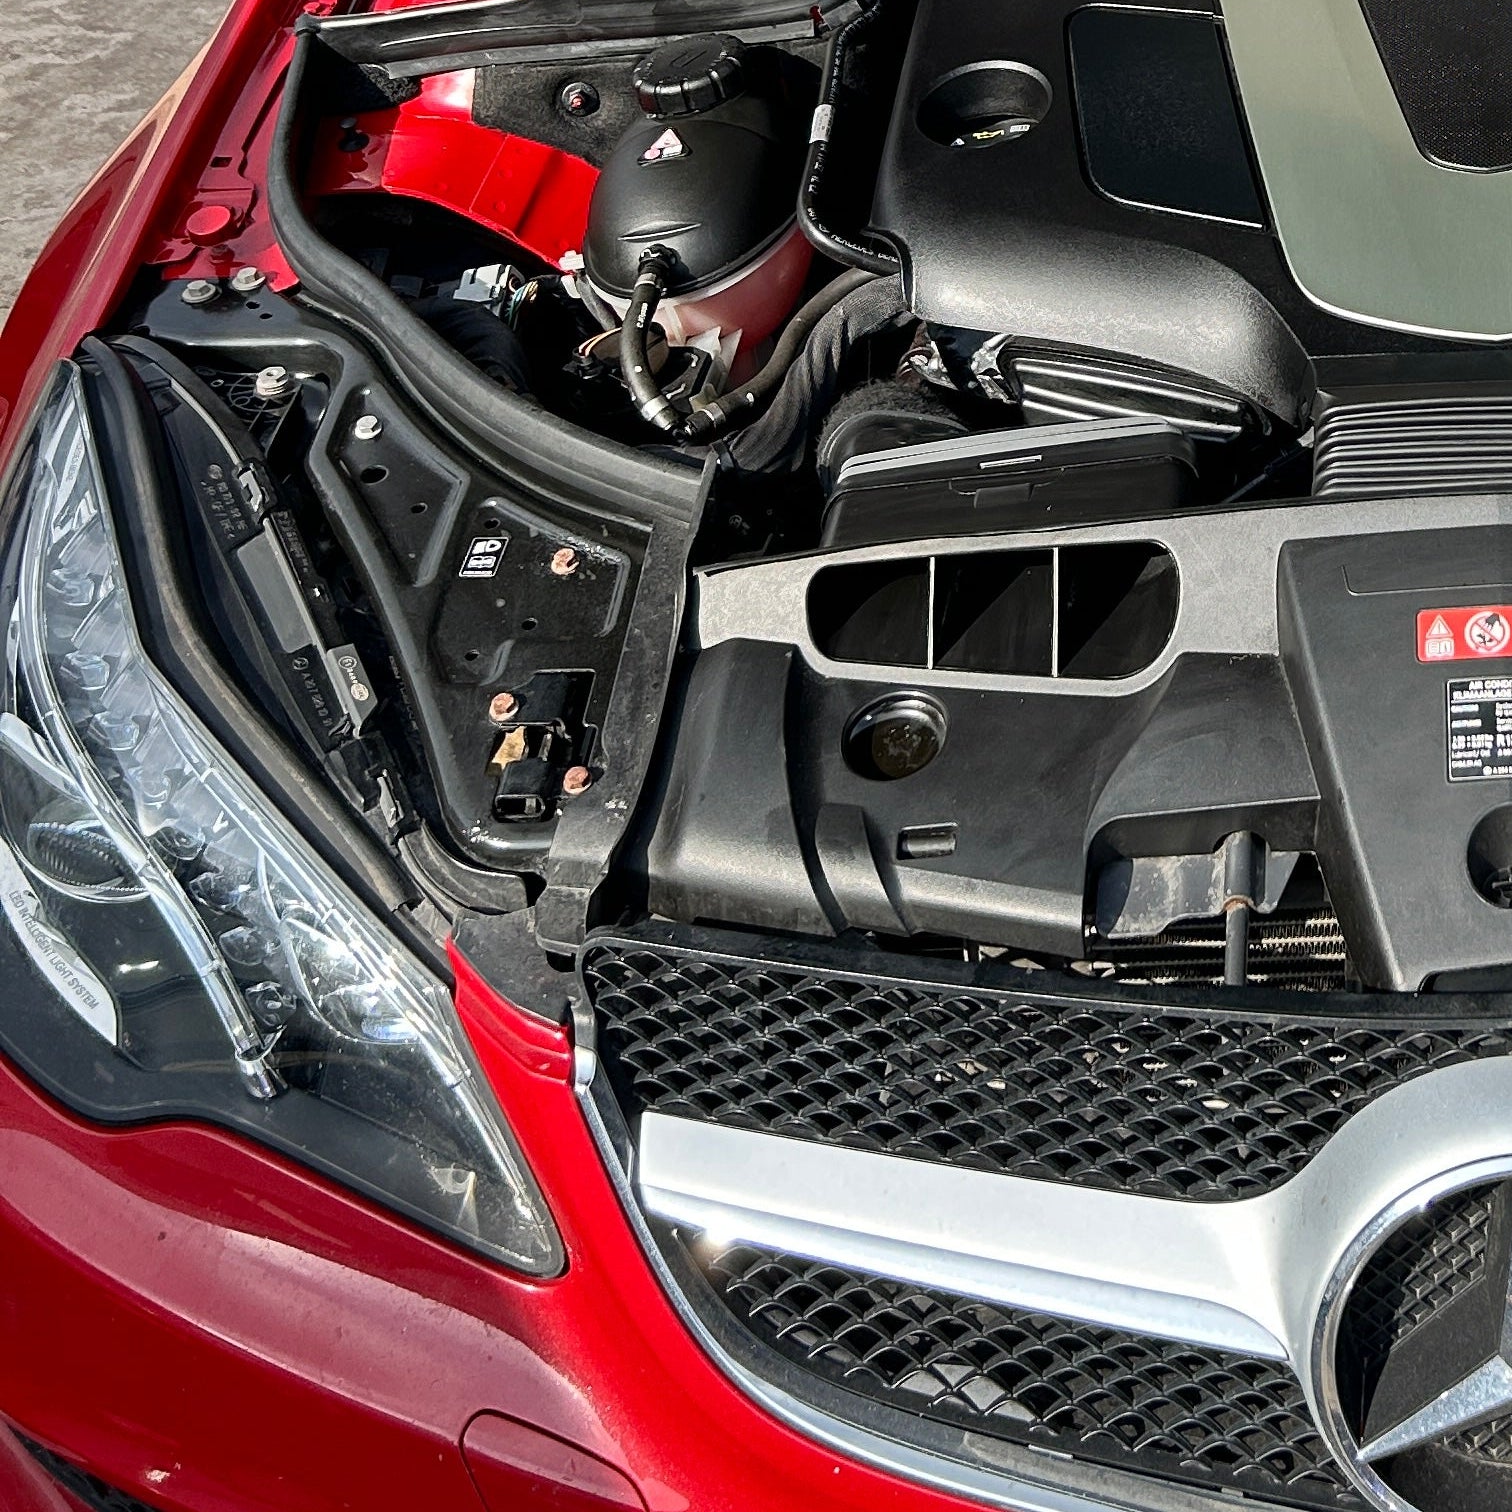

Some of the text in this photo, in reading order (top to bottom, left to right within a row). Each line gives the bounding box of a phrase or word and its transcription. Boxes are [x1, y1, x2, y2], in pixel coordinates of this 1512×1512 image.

[1469, 680, 1483, 690] AIR
[1453, 689, 1512, 700] KLIMAANLAGE
[9, 890, 100, 1009] LED INTELLIGENT LIGHT SYSTEM
